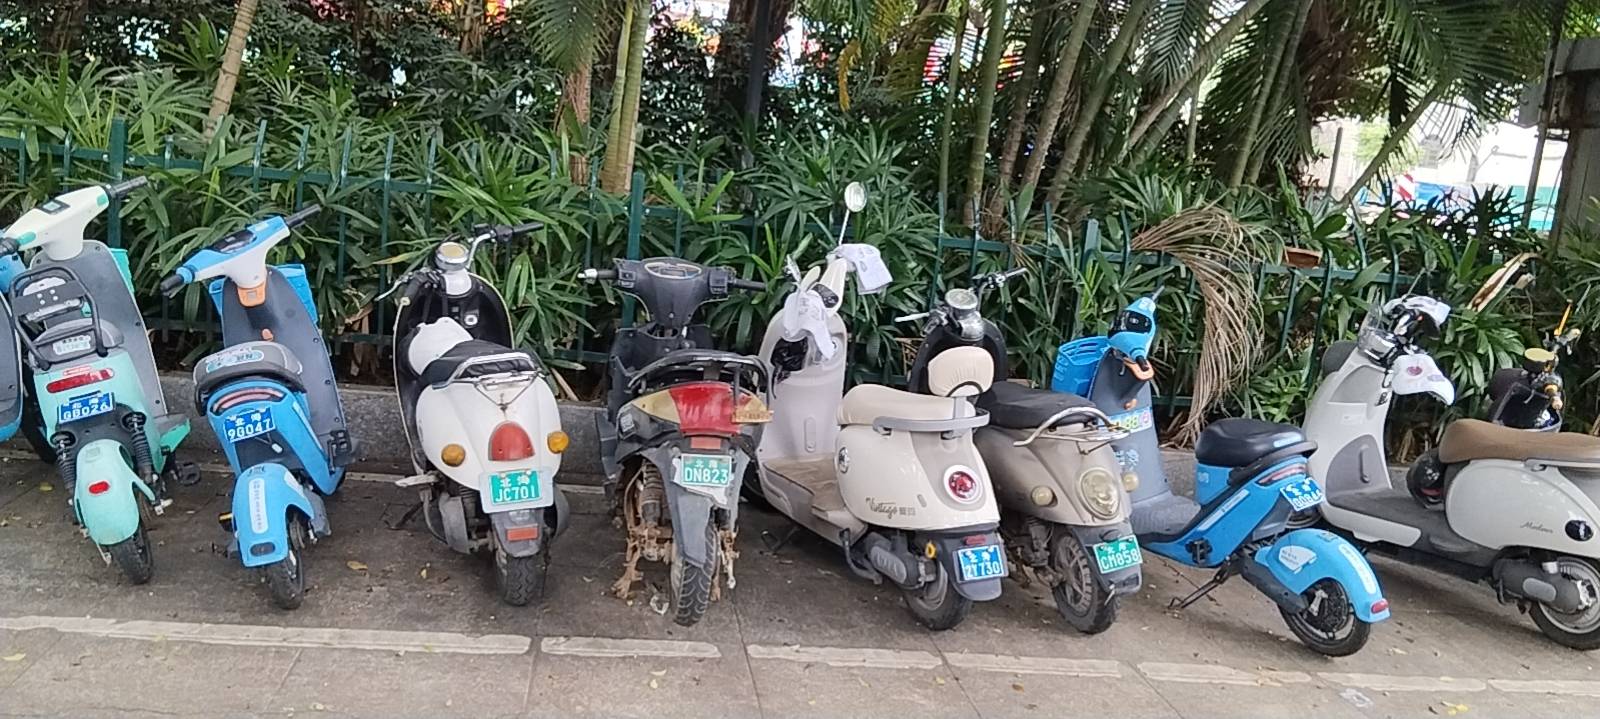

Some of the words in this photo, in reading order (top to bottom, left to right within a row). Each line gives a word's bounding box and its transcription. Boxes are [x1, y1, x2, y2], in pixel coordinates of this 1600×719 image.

[685, 467, 728, 483] DN823
[495, 485, 535, 502] JC701
[1100, 548, 1139, 570] CM858
